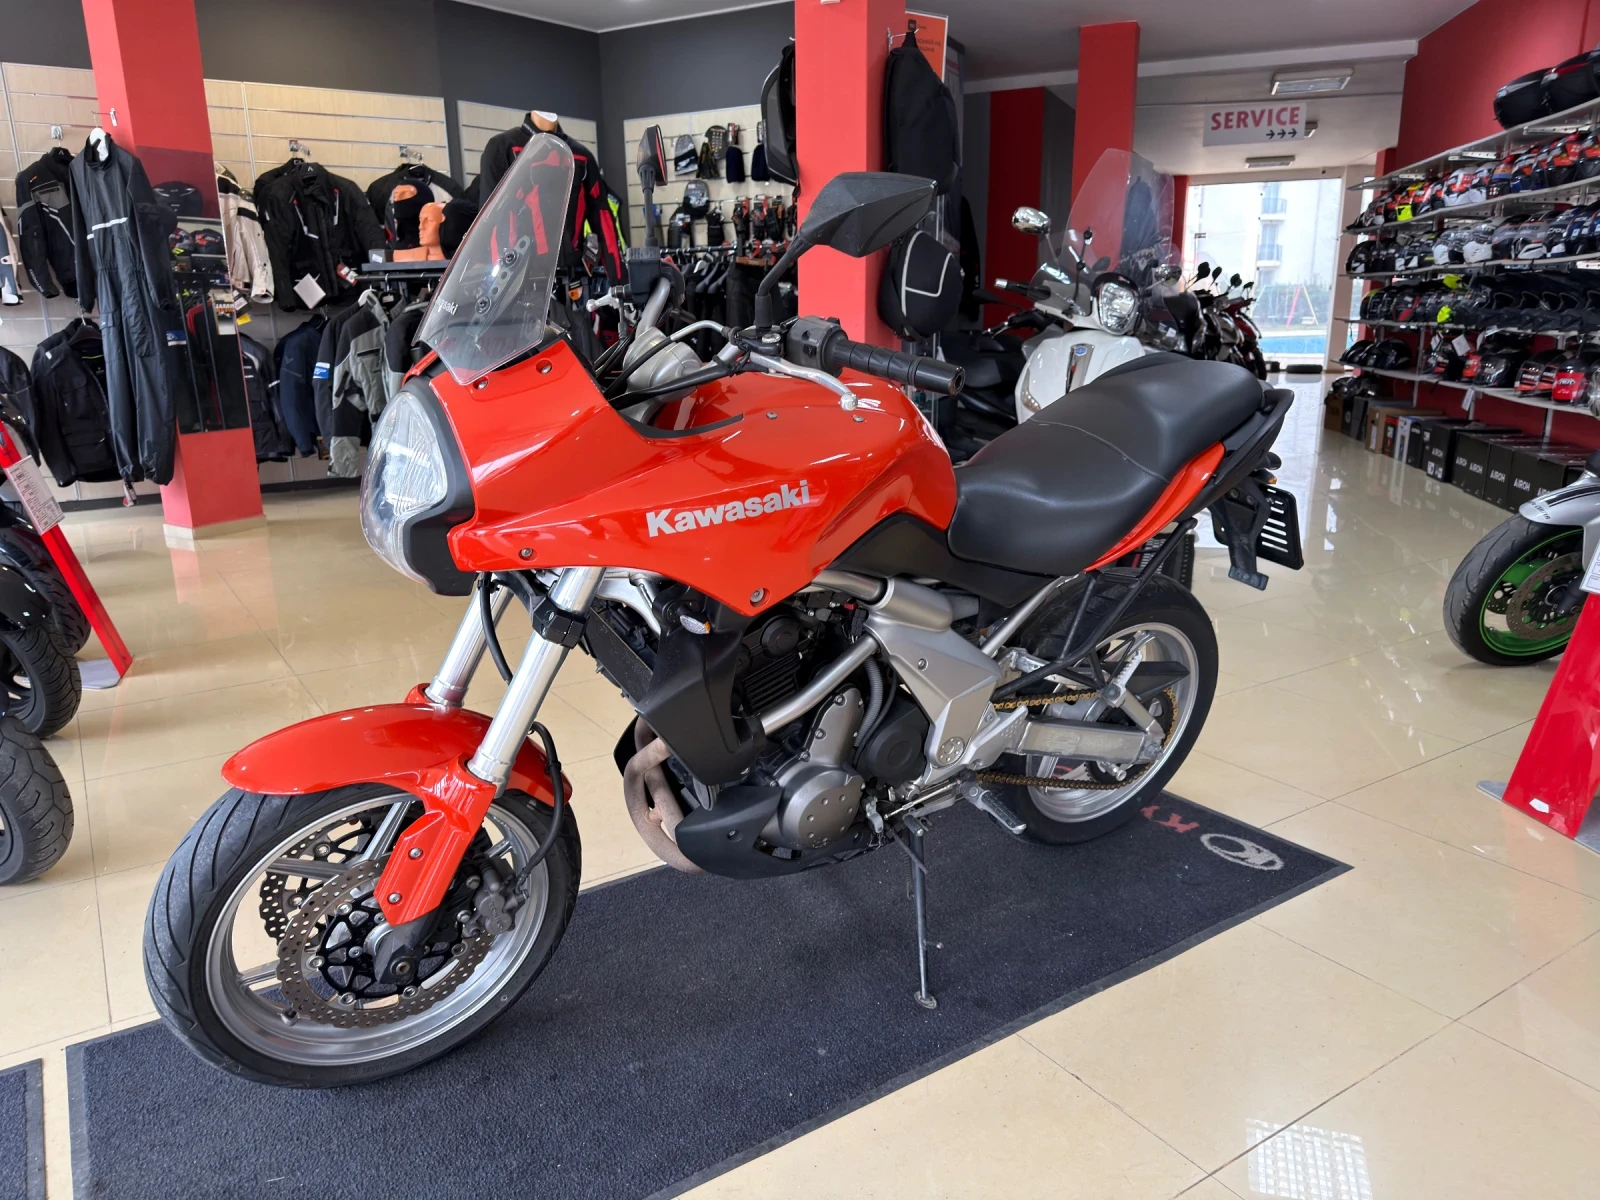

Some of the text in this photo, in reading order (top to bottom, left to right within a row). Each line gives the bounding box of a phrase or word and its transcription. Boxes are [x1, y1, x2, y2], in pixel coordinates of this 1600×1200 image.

[1211, 107, 1300, 131] SERVICE
[1490, 469, 1506, 483] AIROH
[1513, 477, 1531, 492] AIROH
[646, 479, 811, 538] Kawasaki
